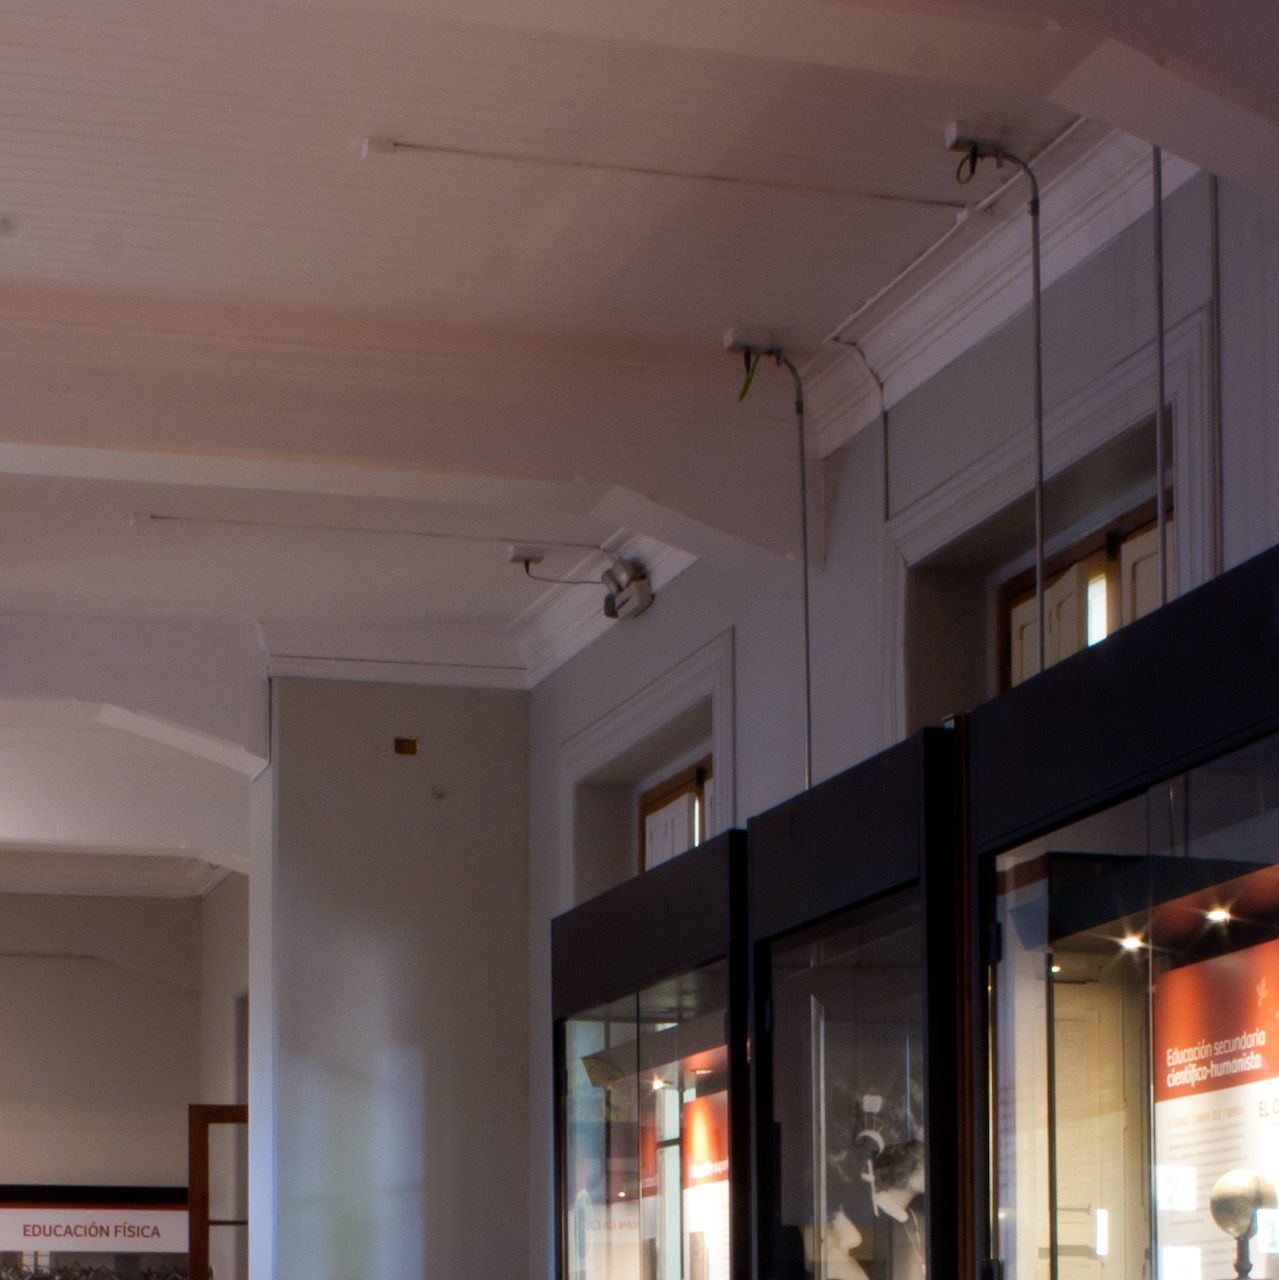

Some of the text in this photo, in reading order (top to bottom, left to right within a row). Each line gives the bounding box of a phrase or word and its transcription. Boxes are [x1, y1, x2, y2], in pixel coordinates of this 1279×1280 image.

[1166, 1027, 1267, 1067] Educación secundaria
[23, 1221, 161, 1239] EDUCACIÓN FÍSICA
